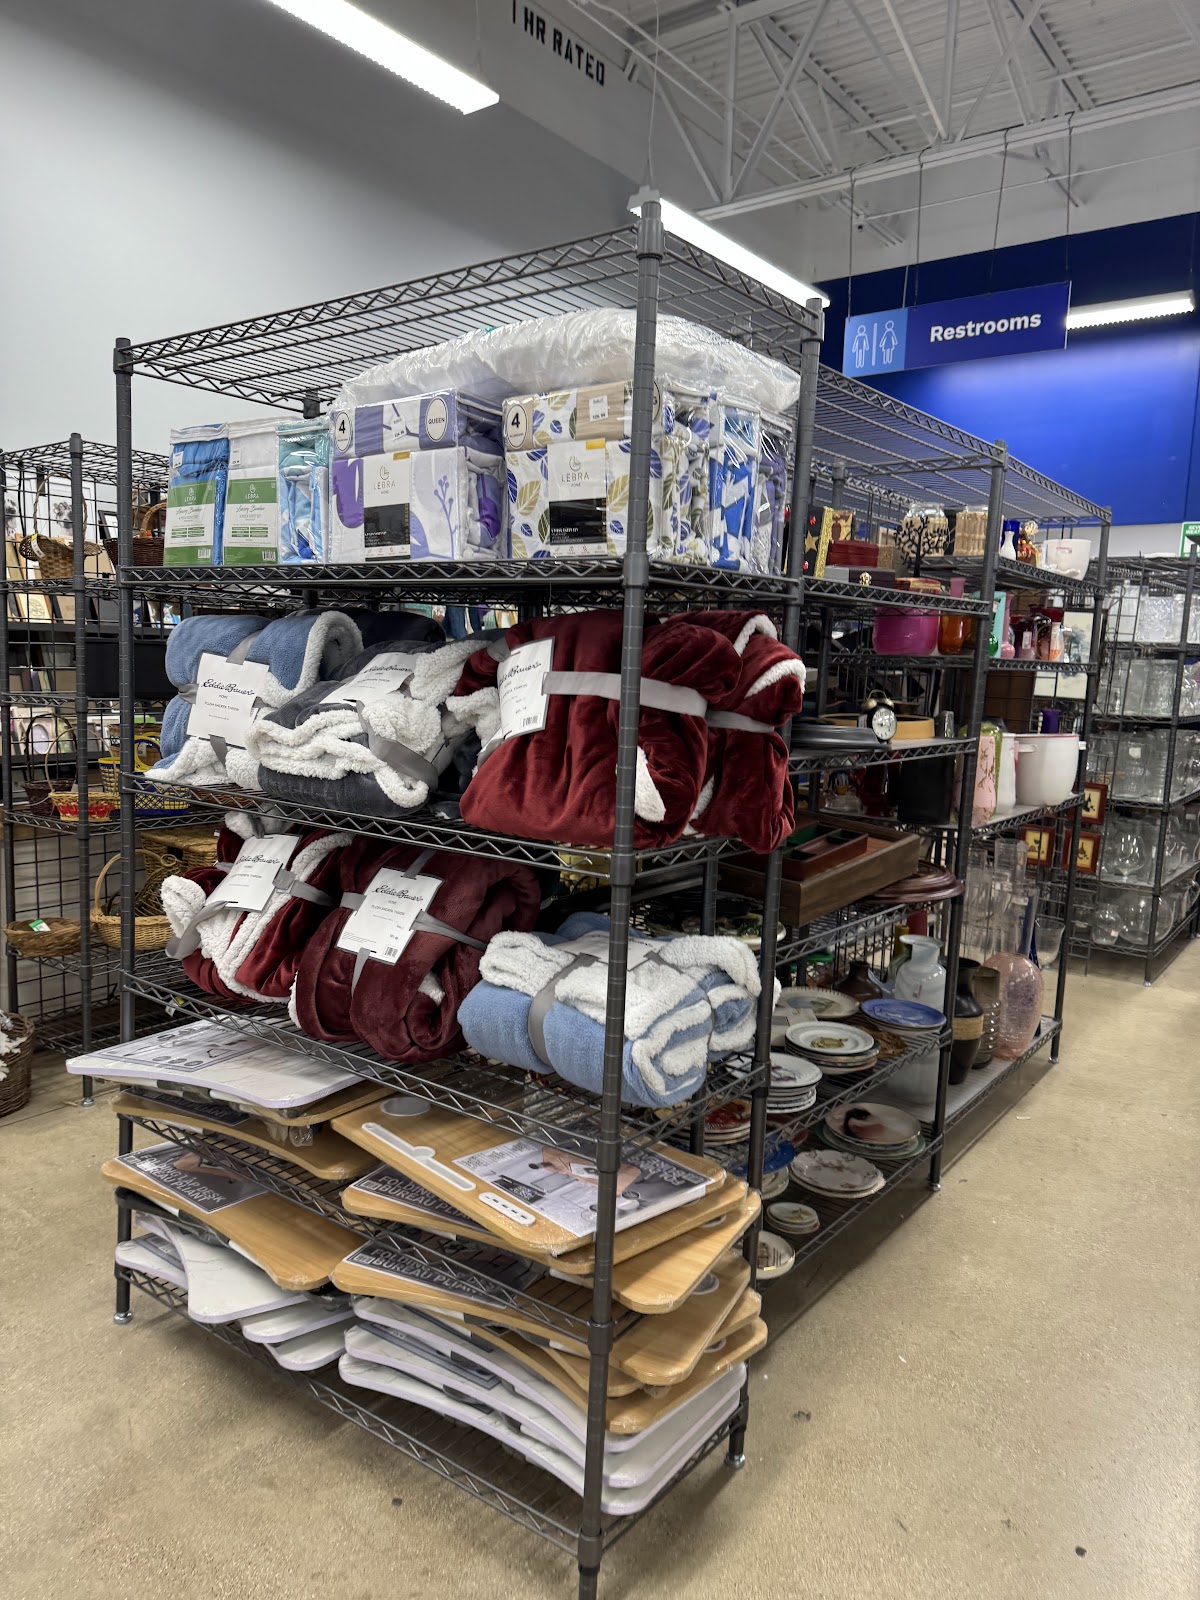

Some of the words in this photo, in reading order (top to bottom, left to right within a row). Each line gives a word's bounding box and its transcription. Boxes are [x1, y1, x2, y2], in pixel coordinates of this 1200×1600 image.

[524, 6, 546, 45] HR
[553, 28, 605, 87] RATED
[930, 313, 1042, 342] Restrooms
[339, 419, 346, 434] 4
[511, 412, 520, 428] 4
[374, 480, 396, 490] LEBRA
[561, 472, 590, 483] LEBRA
[140, 1154, 182, 1177] FOLDING
[198, 1184, 228, 1203] DESK
[171, 1179, 210, 1202] PLIANT
[379, 1183, 437, 1207] BUREAU
[371, 1257, 432, 1279] BUREAU
